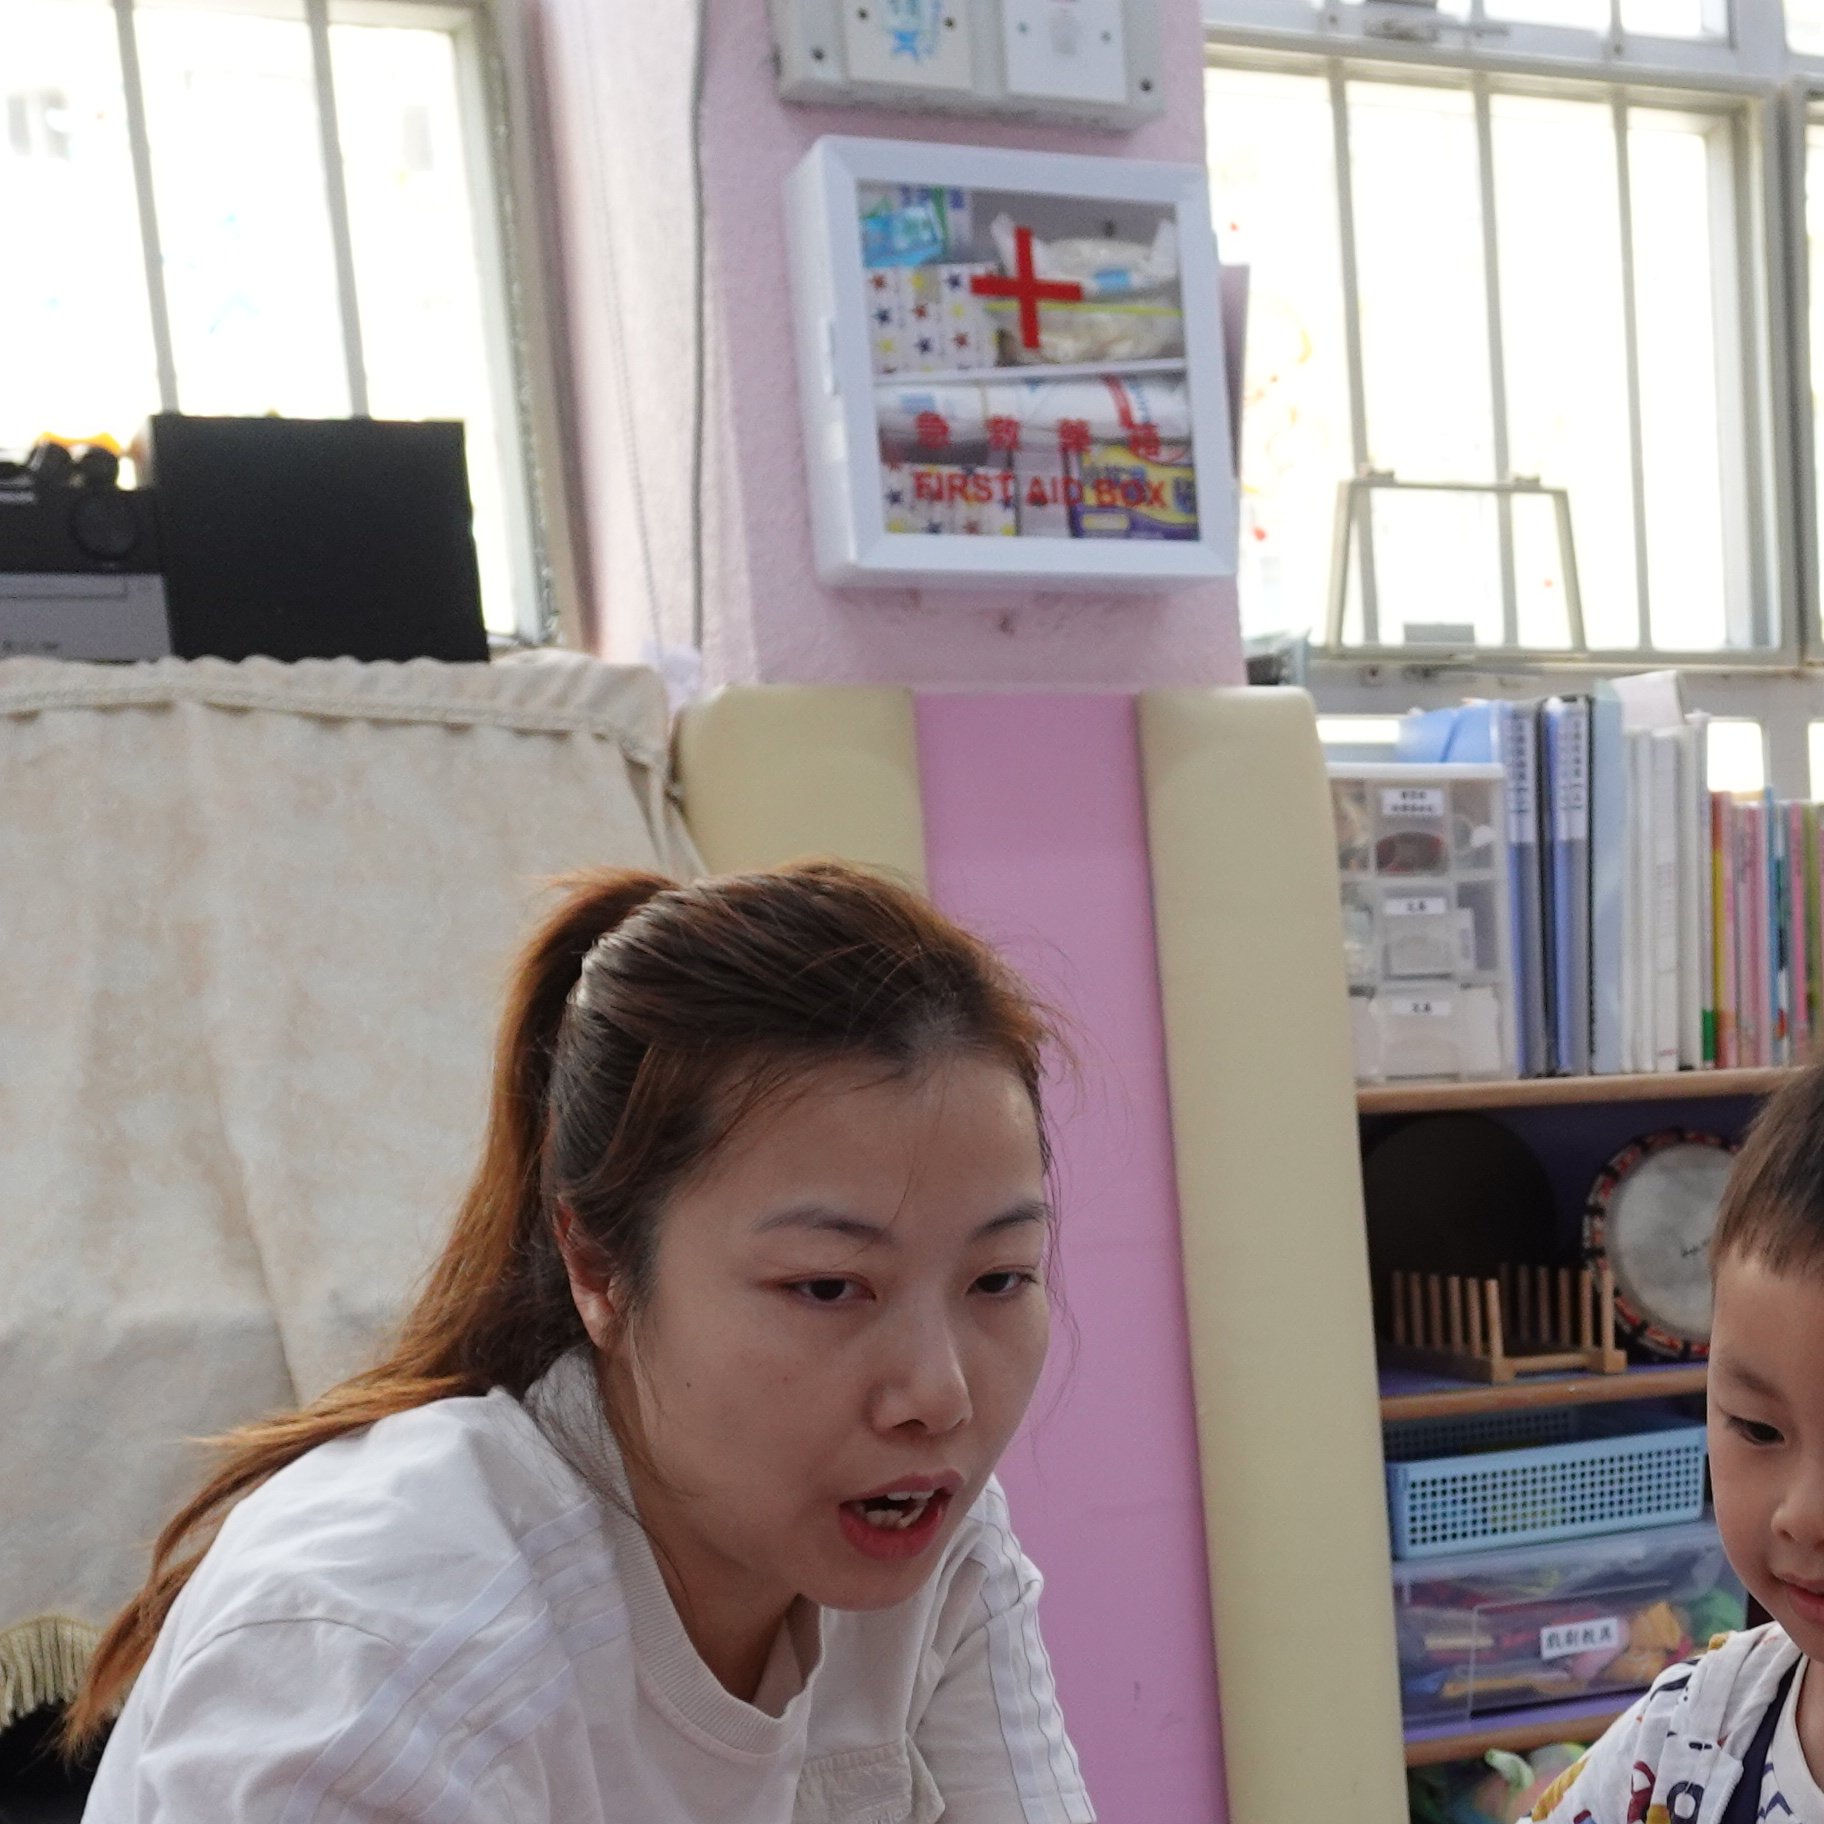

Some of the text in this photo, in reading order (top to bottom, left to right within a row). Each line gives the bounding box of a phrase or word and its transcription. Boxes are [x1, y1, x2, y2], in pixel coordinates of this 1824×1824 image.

[913, 471, 1015, 505] FIRST
[1026, 477, 1084, 506] AID
[1094, 478, 1167, 509] BOX
